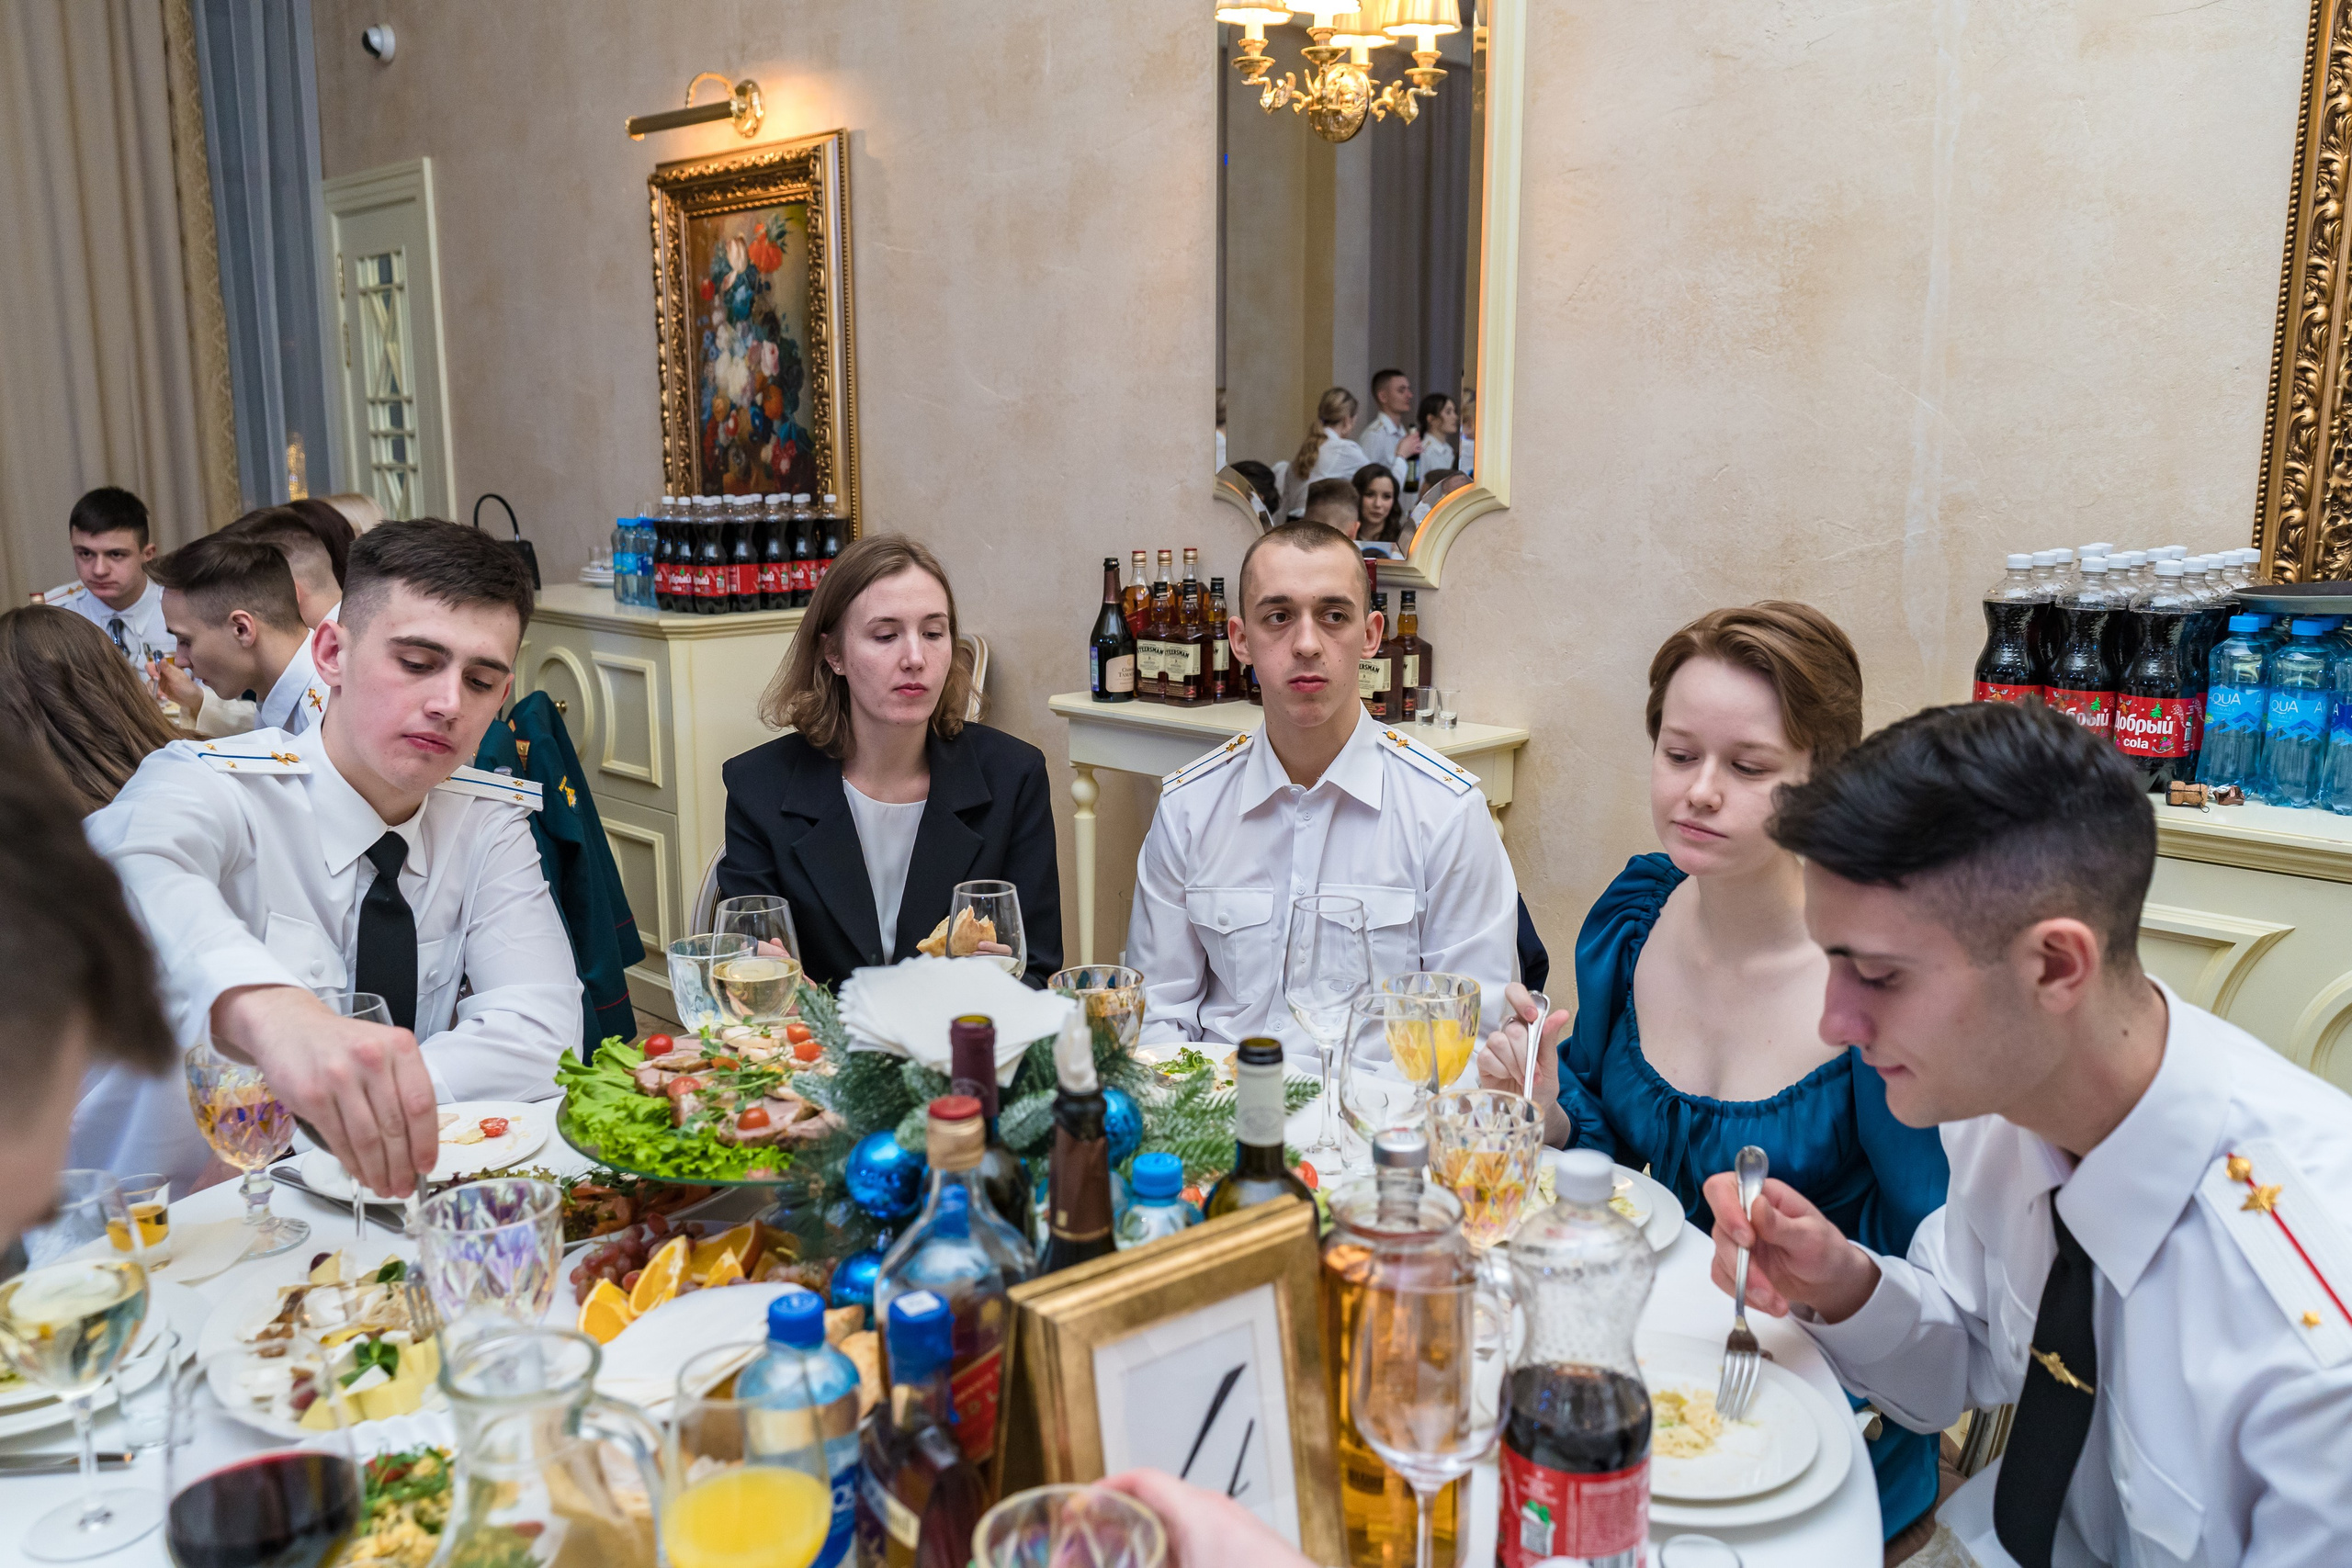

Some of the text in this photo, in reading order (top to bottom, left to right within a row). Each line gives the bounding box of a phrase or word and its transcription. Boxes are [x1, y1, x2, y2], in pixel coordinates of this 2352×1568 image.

[2271, 699, 2299, 715] QUA
[2114, 710, 2175, 736] Добрый
[2123, 737, 2149, 750] cola
